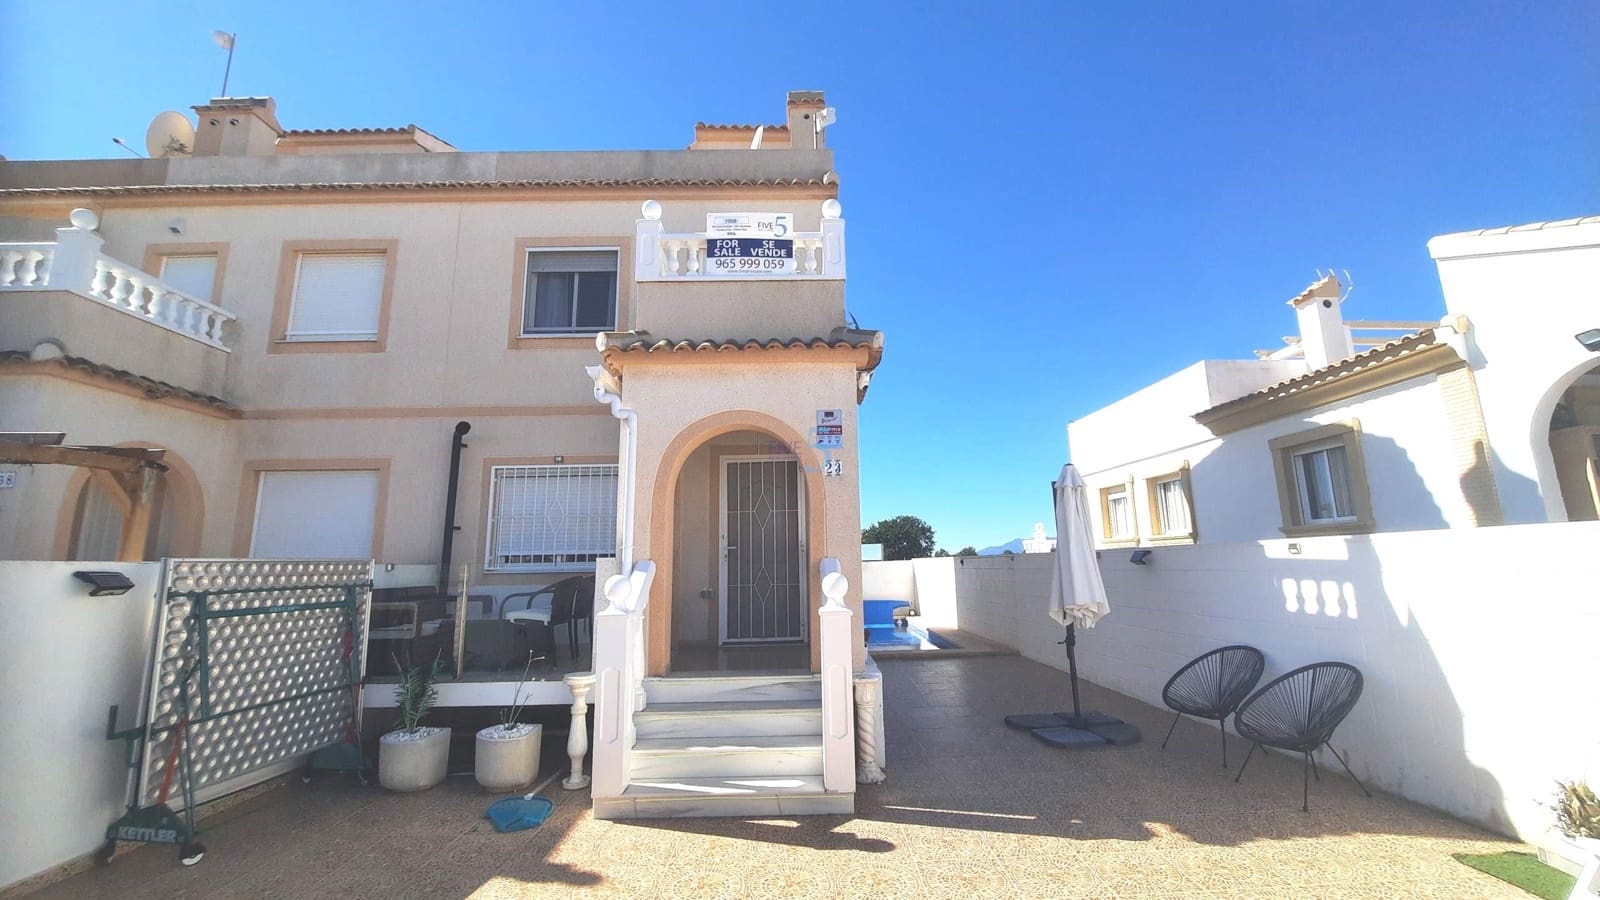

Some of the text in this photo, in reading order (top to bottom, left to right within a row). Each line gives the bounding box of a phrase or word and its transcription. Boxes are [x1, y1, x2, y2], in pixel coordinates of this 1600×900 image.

[757, 216, 788, 237] FIVE 5
[716, 240, 739, 248] FOR
[762, 241, 775, 249] SE
[714, 248, 741, 256] SALE
[750, 248, 787, 257] VENDE
[715, 258, 785, 269] 965 999 059
[825, 462, 841, 474] 23
[119, 827, 176, 842] KETTLER
